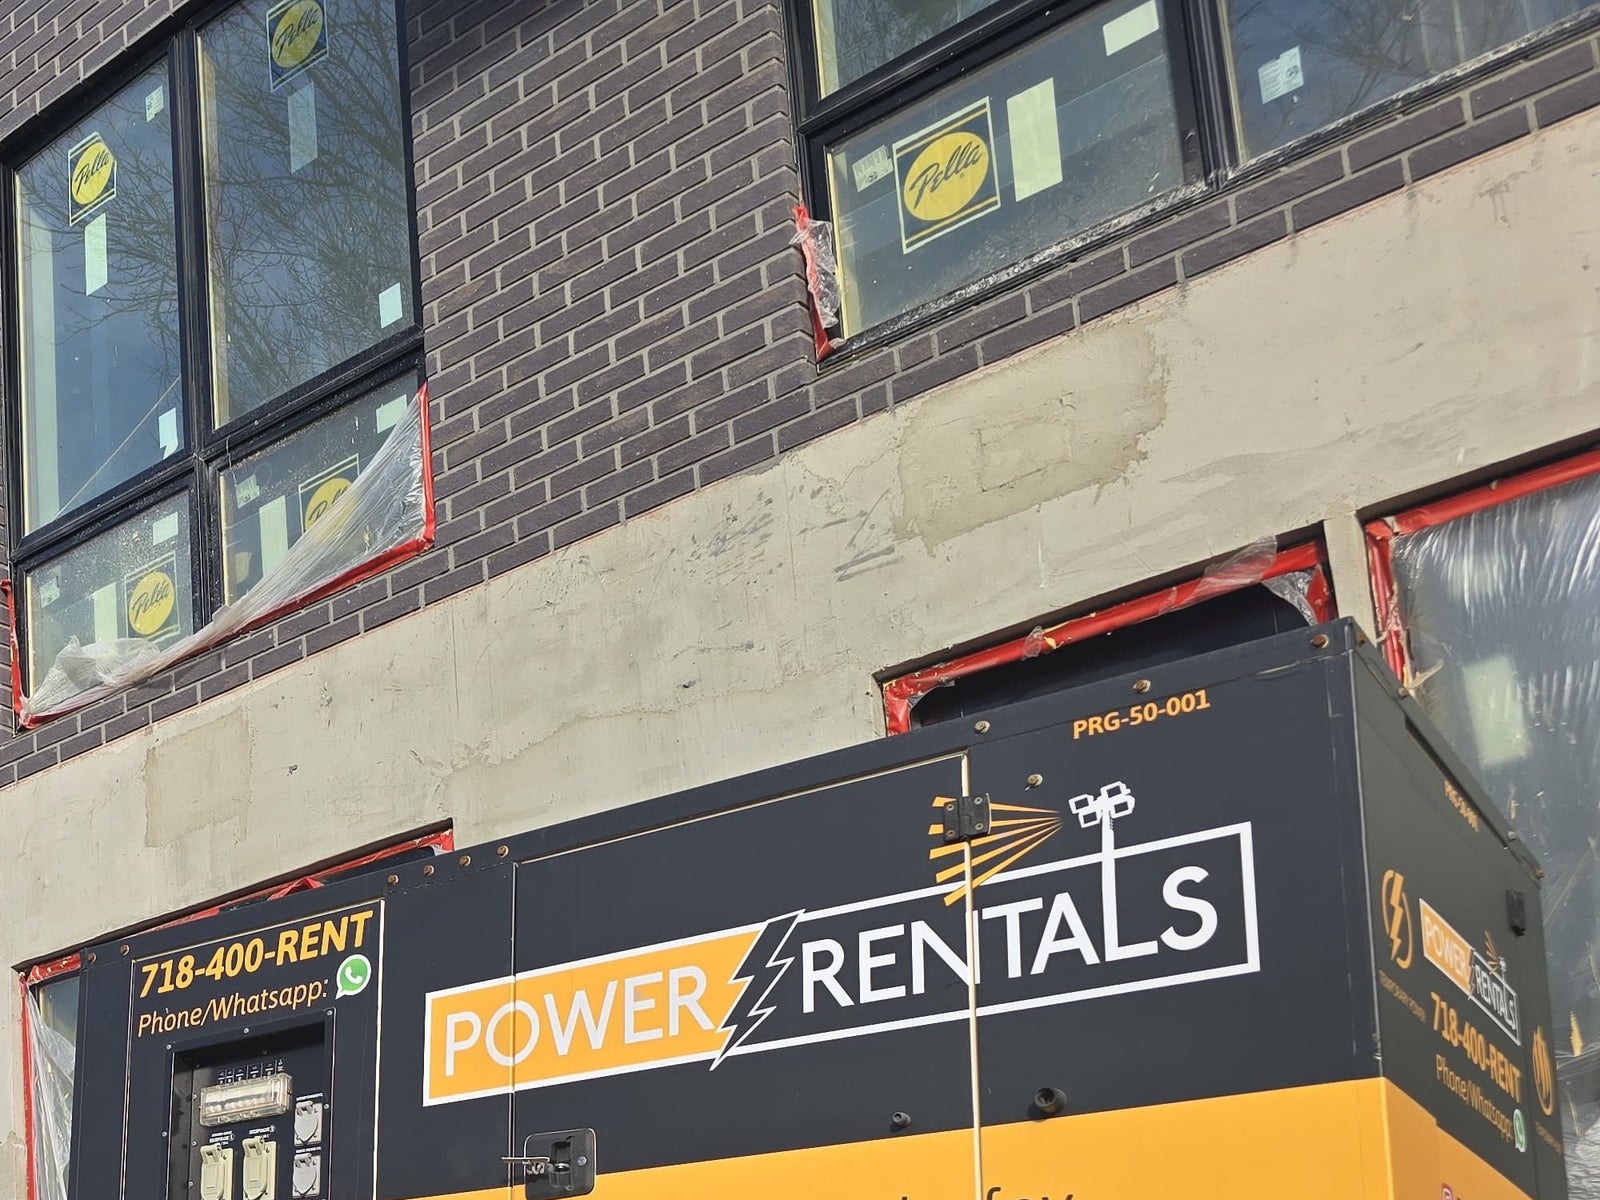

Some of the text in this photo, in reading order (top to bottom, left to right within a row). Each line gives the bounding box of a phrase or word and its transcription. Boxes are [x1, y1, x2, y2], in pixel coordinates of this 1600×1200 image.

[74, 149, 111, 196] Pella
[908, 141, 985, 210] Pella
[131, 579, 172, 624] Pella
[1072, 689, 1212, 740] PRG-50-001
[139, 910, 374, 998] 718-400-RENT
[445, 864, 1219, 1077] POWER RENTALS
[1422, 916, 1517, 1031] POWER RENTALS
[137, 978, 329, 1038] Phone/Whatsapp:
[1430, 991, 1523, 1103] 718-400-RENT
